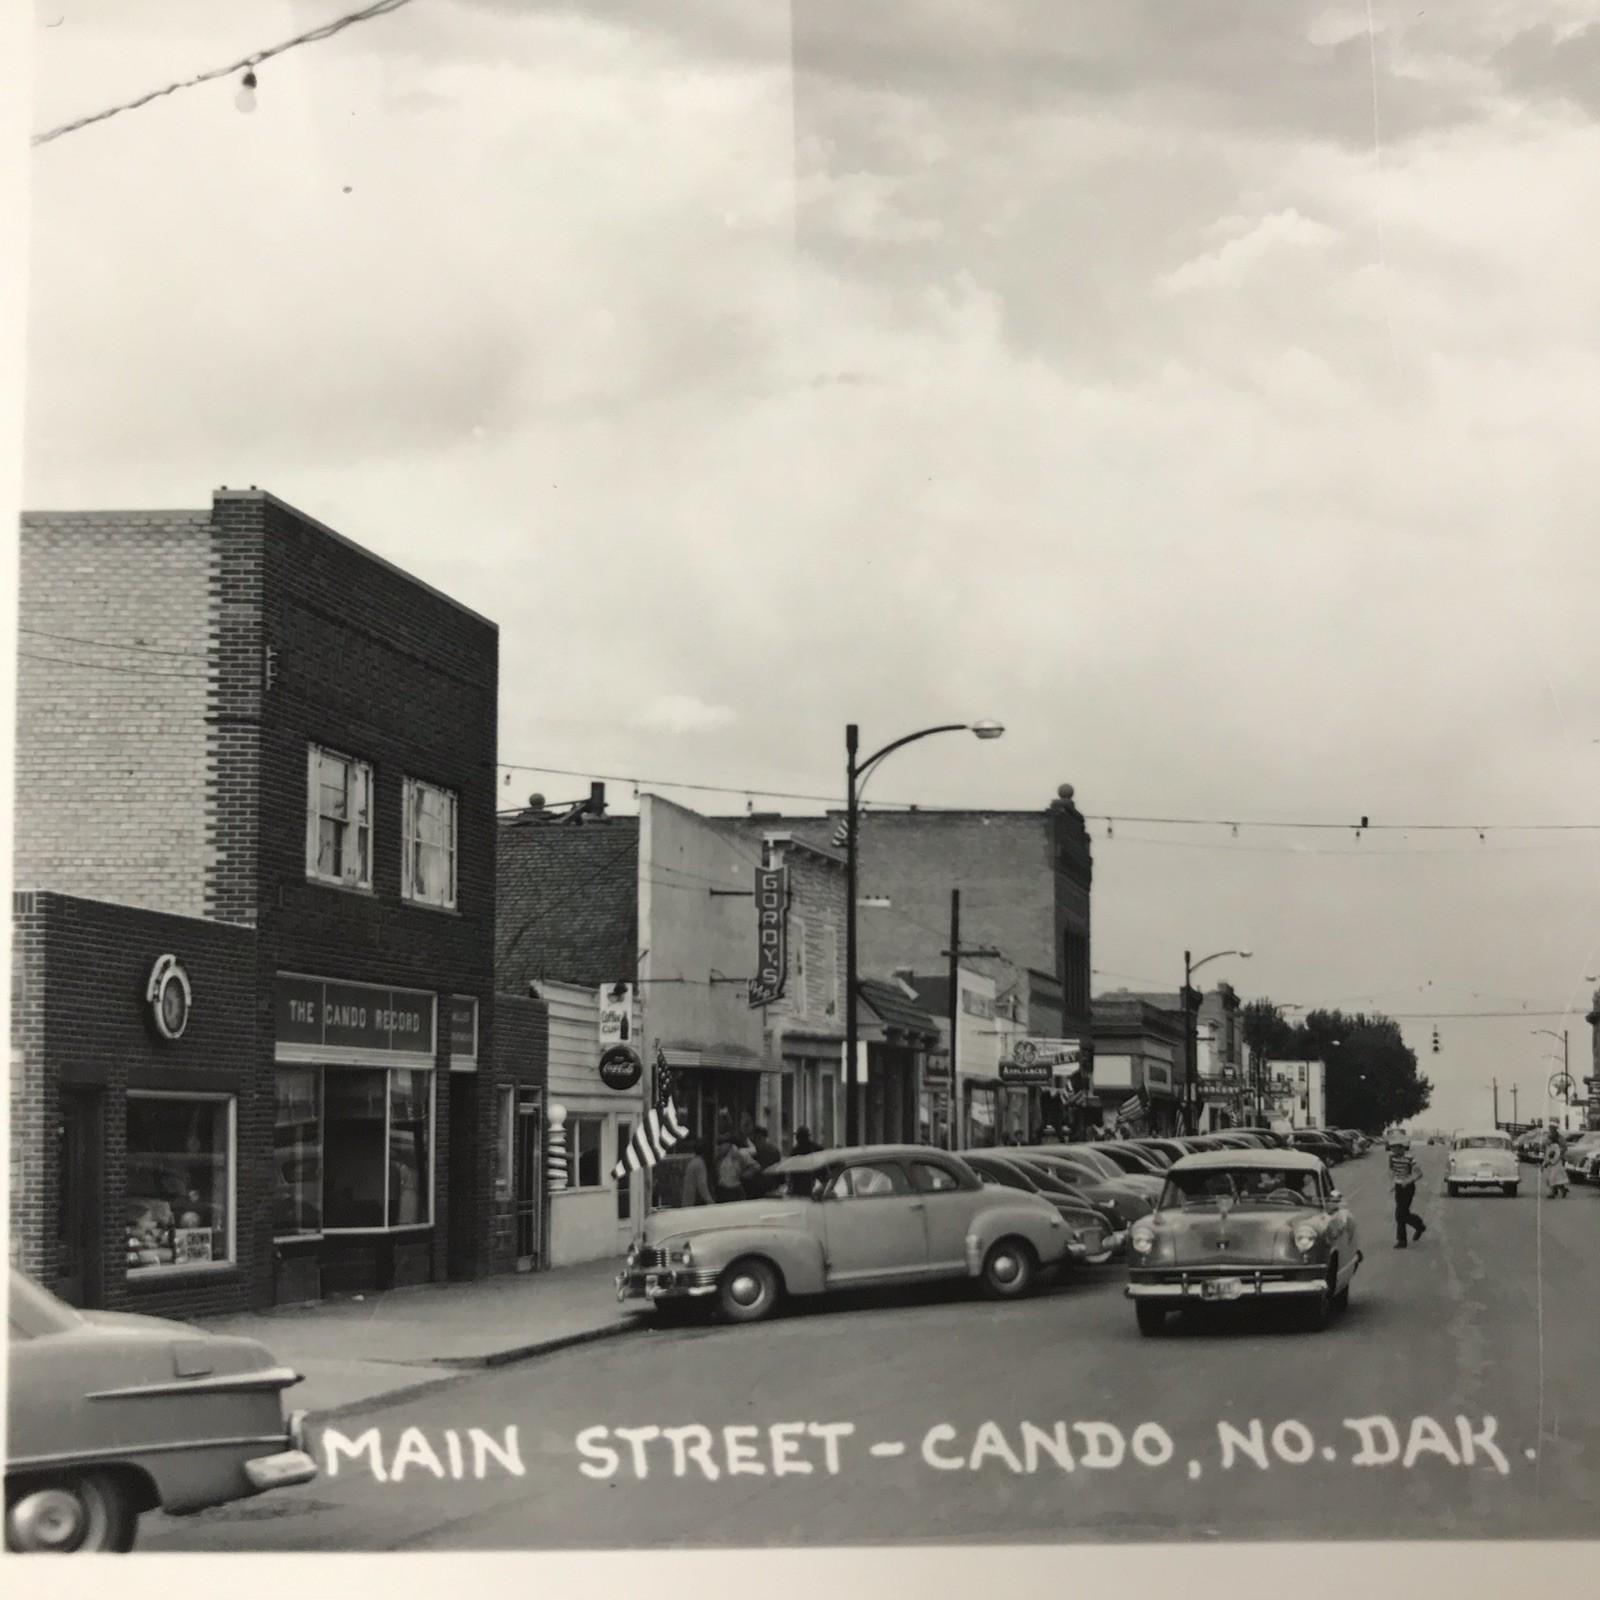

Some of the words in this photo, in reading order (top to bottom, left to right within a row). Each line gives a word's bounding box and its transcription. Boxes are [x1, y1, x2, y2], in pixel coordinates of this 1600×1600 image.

[289, 999, 315, 1023] THE
[325, 1004, 367, 1029] CANDO
[375, 1009, 420, 1034] RECORD
